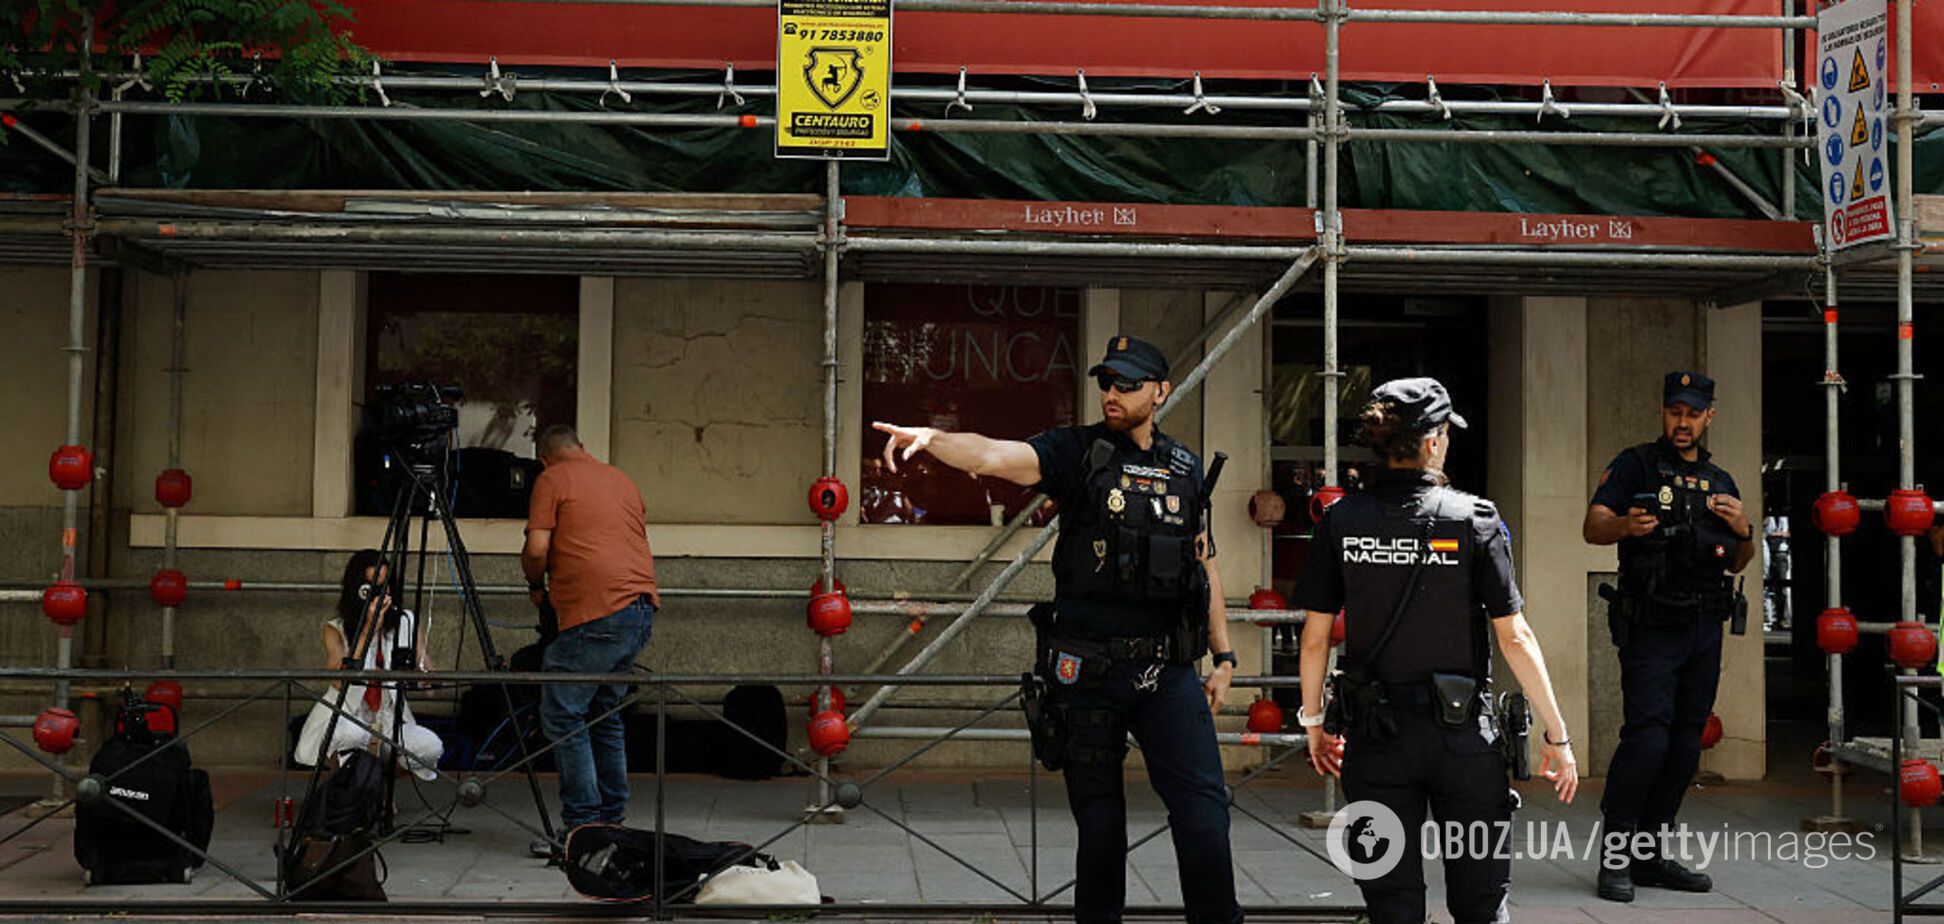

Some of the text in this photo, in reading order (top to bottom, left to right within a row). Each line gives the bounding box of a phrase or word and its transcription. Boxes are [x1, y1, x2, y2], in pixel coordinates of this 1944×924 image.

[799, 29, 884, 42] 91 7853880
[794, 115, 871, 128] CENTAURO
[1024, 205, 1104, 228] Layher
[1521, 218, 1600, 241] Layher
